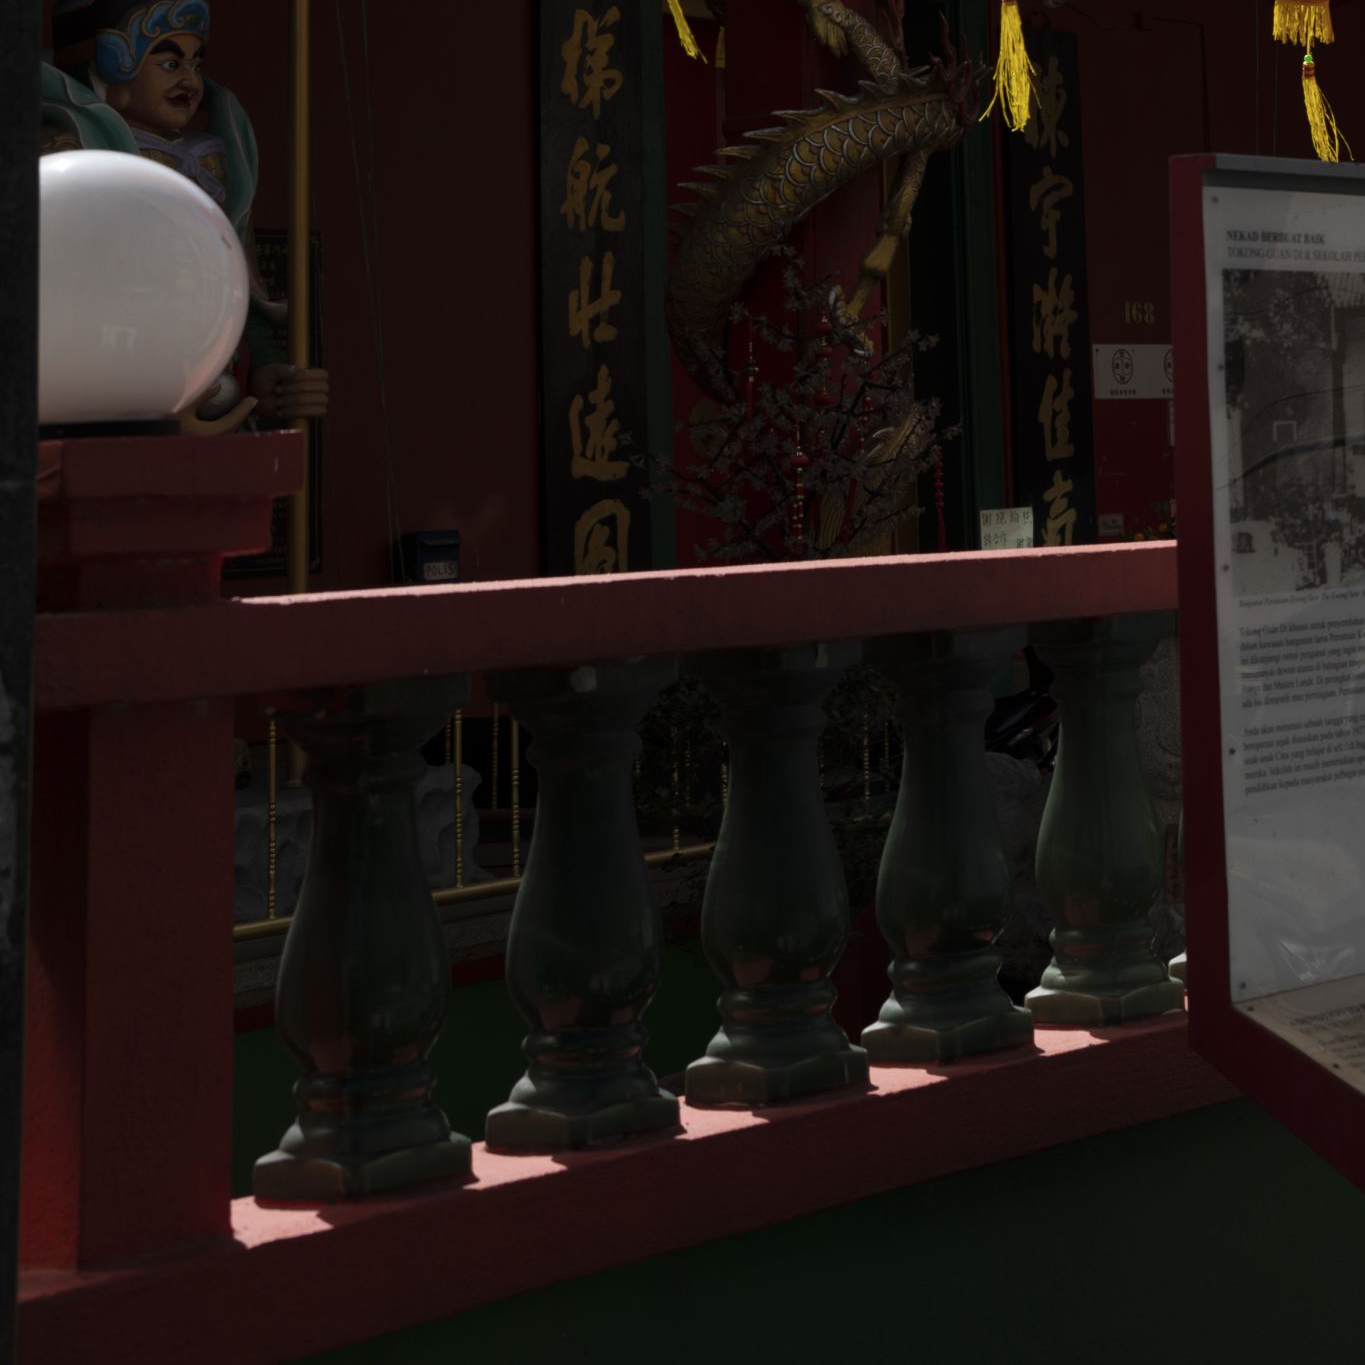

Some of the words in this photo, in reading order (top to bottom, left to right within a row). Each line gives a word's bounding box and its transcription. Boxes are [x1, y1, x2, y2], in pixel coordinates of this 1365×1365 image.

[1226, 230, 1259, 242] NEKAD
[1260, 231, 1302, 243] BERBUAT
[1303, 232, 1326, 244] BAIK
[1312, 249, 1352, 262] SEKOLAH
[1124, 300, 1155, 324] 168
